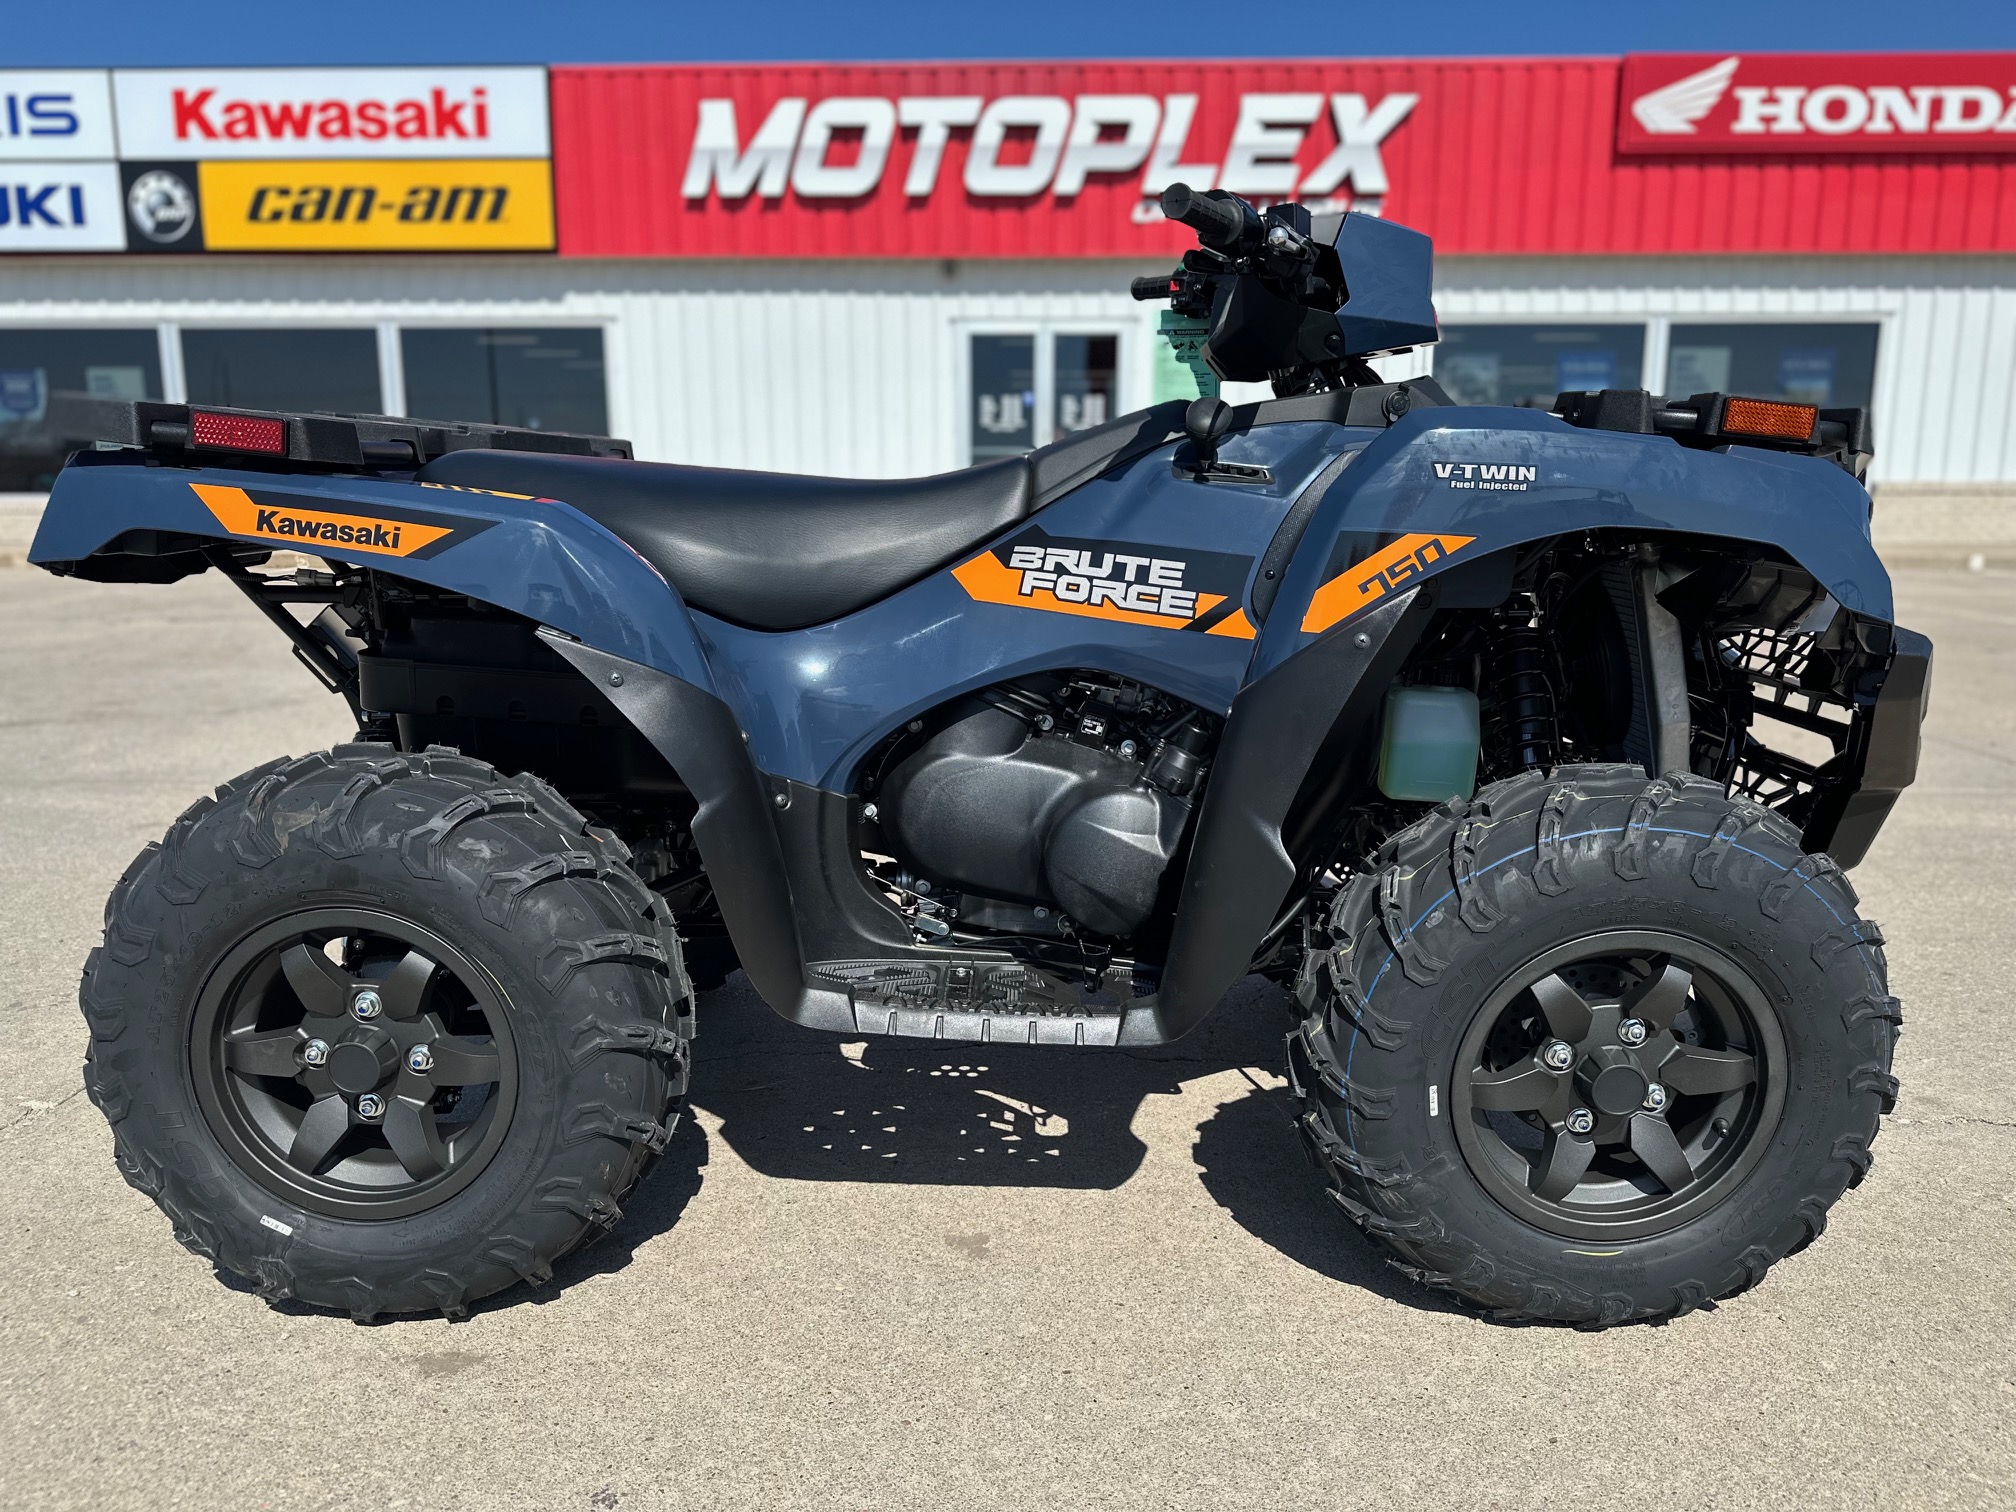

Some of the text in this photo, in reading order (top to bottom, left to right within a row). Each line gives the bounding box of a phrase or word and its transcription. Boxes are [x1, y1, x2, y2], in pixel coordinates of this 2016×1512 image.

[0, 94, 80, 137] IS
[171, 87, 490, 141] Kawasaki
[681, 93, 1417, 199] MOTOPLEX
[0, 183, 87, 228] KI
[246, 184, 510, 225] can-am
[1433, 462, 1537, 482] V-TWIN
[1450, 480, 1528, 491] Fuel Injected
[255, 508, 402, 549] Kawasaki
[1008, 545, 1187, 588] BRUTE
[1357, 538, 1449, 595] 750
[1020, 570, 1197, 618] FORCE
[1421, 941, 1497, 1060] CST
[143, 1102, 239, 1213] CST
